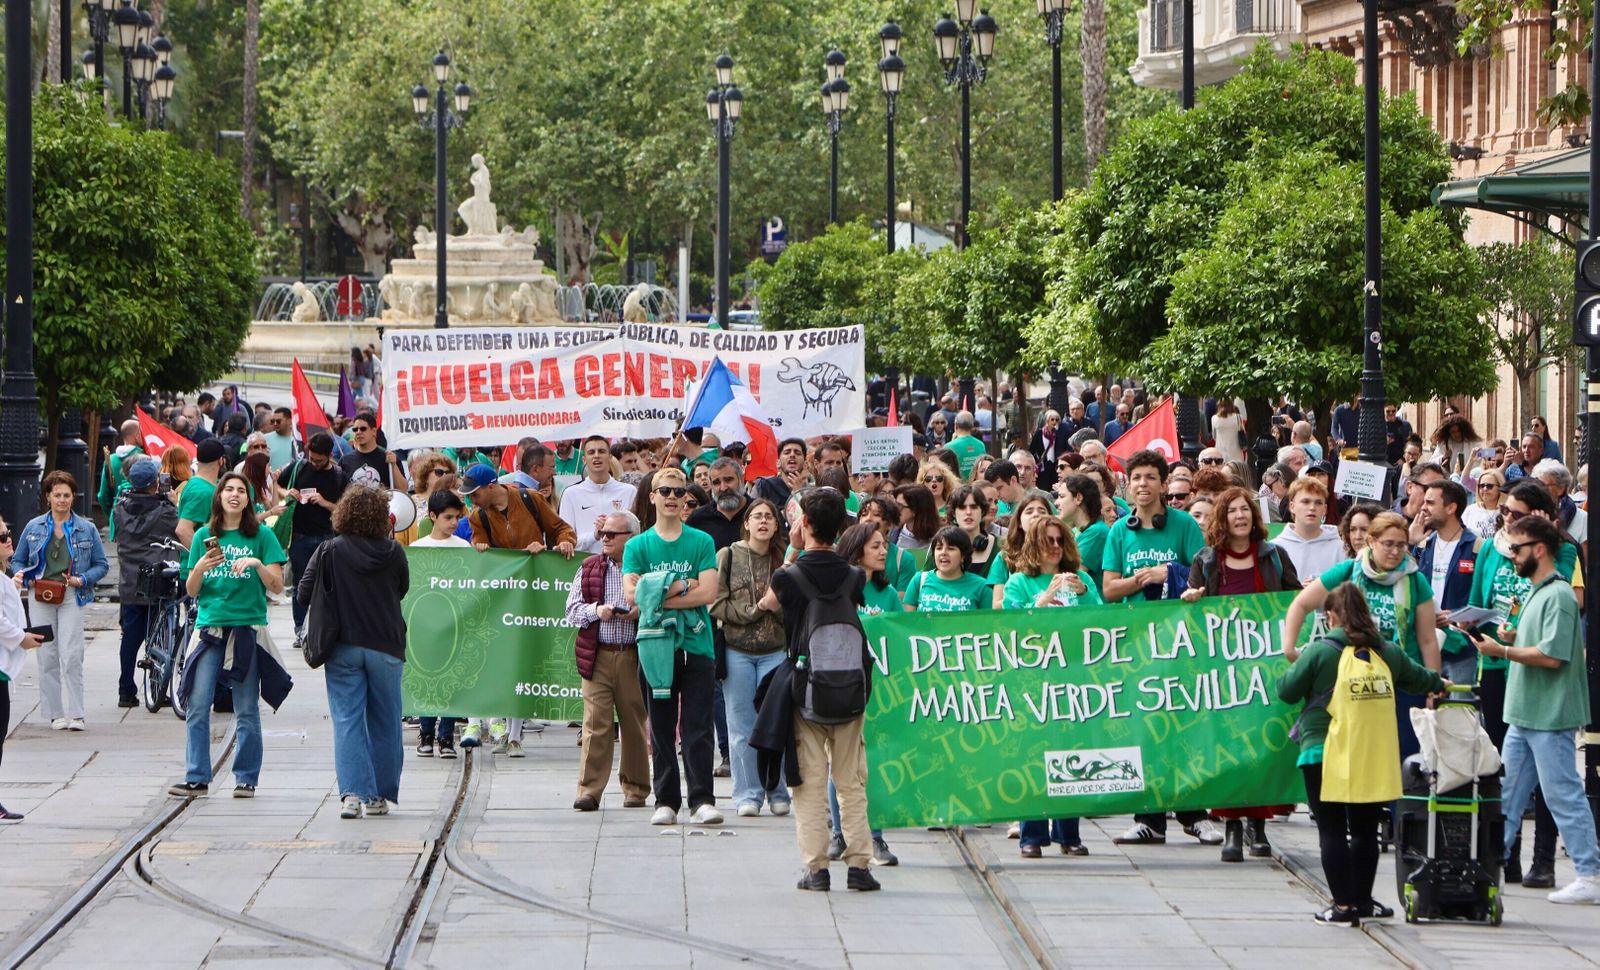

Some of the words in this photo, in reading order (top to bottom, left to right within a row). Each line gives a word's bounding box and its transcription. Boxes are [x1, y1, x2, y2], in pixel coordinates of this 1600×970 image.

[391, 335, 433, 352] PARA
[436, 333, 512, 352] DEFENDER
[517, 332, 549, 350] UNA
[690, 332, 710, 348] DE
[713, 333, 778, 352] CALIDAD
[784, 334, 795, 350] Y
[798, 326, 860, 349] SEGURA
[396, 357, 566, 412] ¡HUELGA
[574, 350, 761, 404] GENER!
[603, 406, 666, 422] Sindicato
[399, 414, 468, 434] IZQUIERDA
[486, 411, 582, 428] REVOLUCIONARIA
[430, 576, 453, 590] Por
[458, 578, 476, 590] un
[480, 576, 527, 590] centro
[531, 577, 549, 590] de
[554, 577, 573, 591] tra
[502, 612, 572, 627] Conserva
[867, 636, 889, 676] N
[908, 630, 1068, 673] DEFENSA
[1082, 626, 1133, 666] DE
[1148, 620, 1196, 660] LA
[1205, 607, 1327, 662] PÚBLIA
[514, 682, 583, 698] #SOSCons
[909, 681, 1015, 724] MAREA
[1023, 681, 1131, 724] VERDE
[1136, 664, 1269, 712] SEVILLA
[1350, 681, 1392, 694] CALR
[1049, 785, 1075, 795] MAREA
[1077, 783, 1106, 793] VERDE
